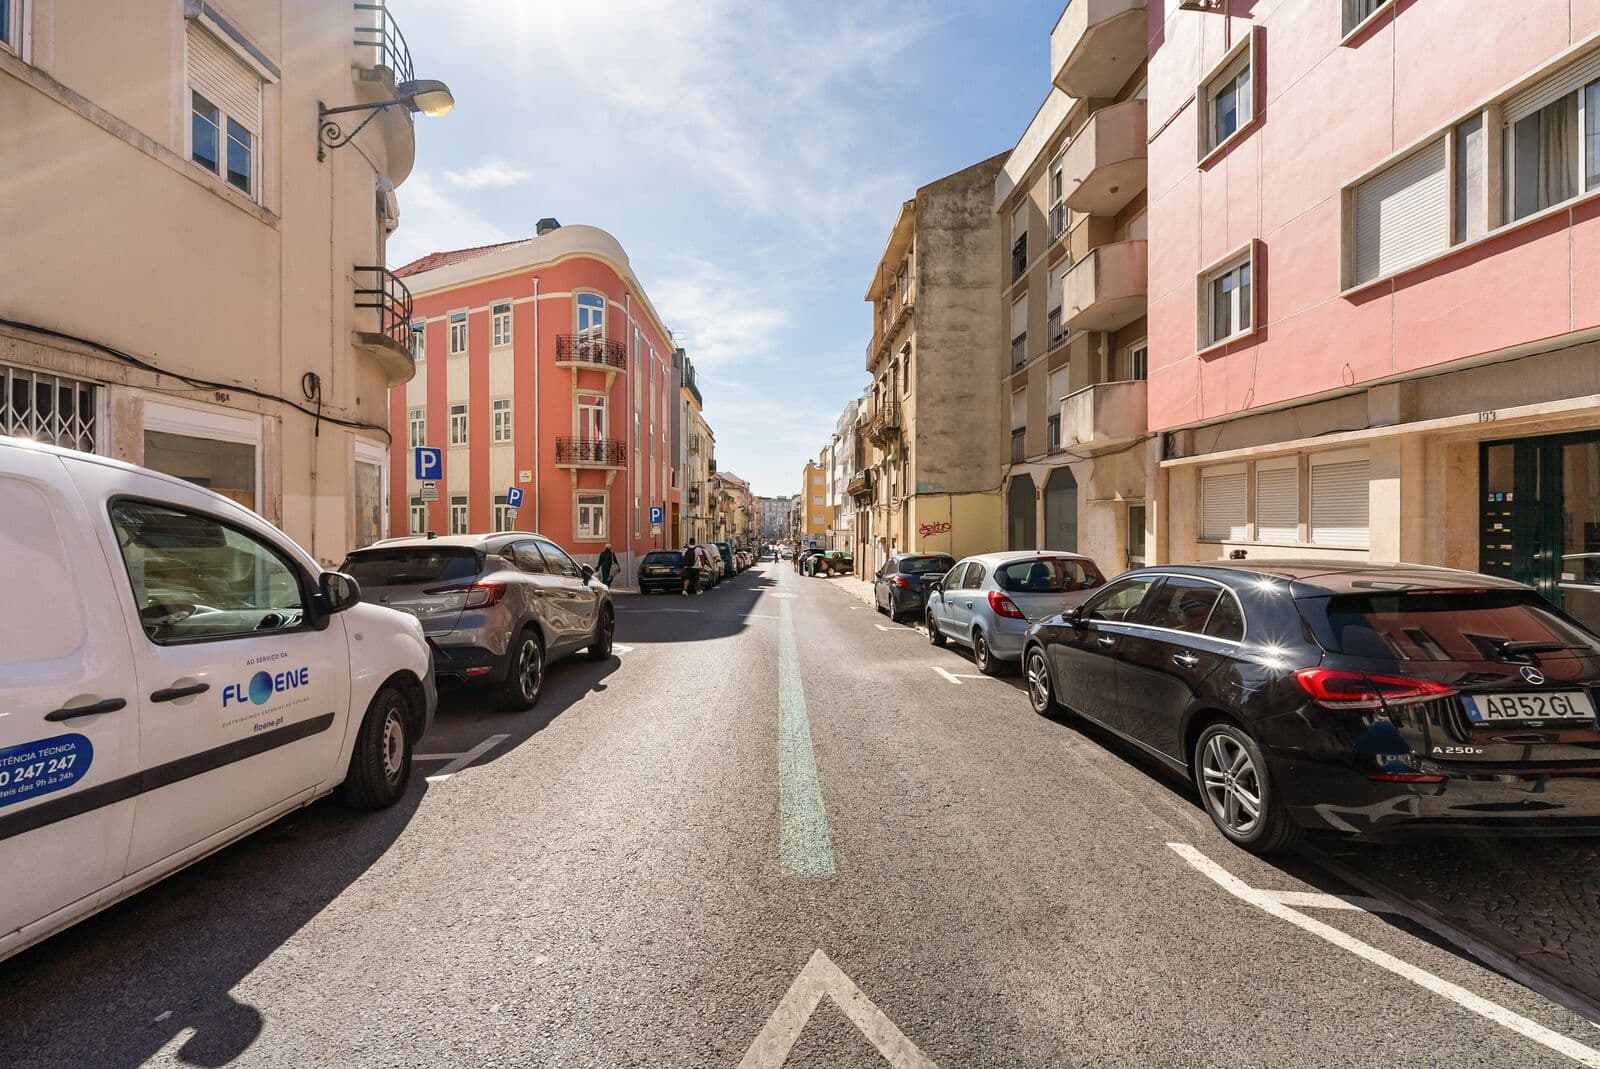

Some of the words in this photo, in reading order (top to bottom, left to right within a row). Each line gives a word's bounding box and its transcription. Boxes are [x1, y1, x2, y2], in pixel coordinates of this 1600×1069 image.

[1479, 411, 1496, 424] 193
[420, 450, 437, 477] P
[509, 489, 520, 504] P
[651, 508, 660, 522] P
[222, 666, 309, 707] FLOENE
[1486, 695, 1585, 718] AB52GL
[253, 716, 284, 732] floene.pt
[0, 753, 36, 767] TÊNCIA
[39, 743, 76, 757] TÉCNICA
[13, 762, 45, 782] 247
[48, 754, 77, 774] 247
[18, 783, 34, 793] das
[36, 779, 46, 788] 9h
[59, 772, 74, 782] 24h
